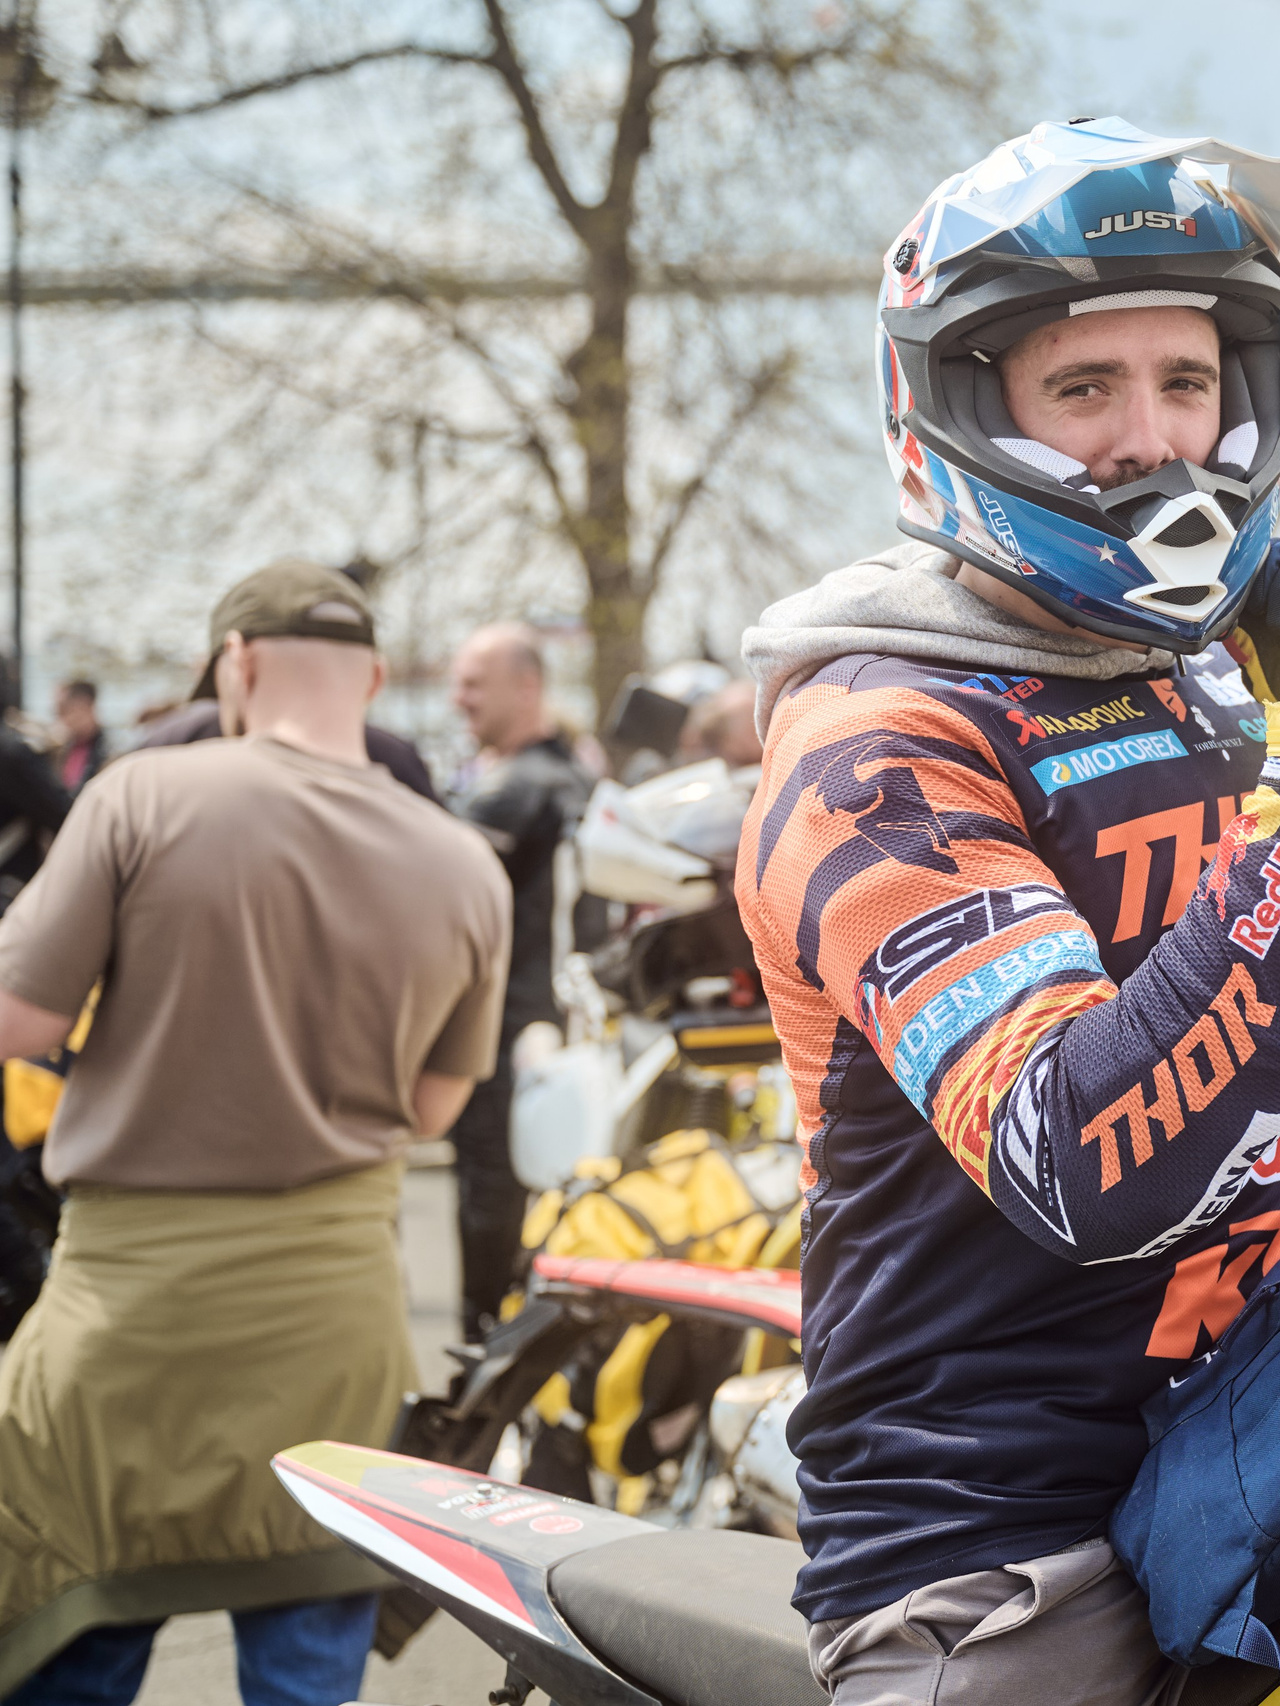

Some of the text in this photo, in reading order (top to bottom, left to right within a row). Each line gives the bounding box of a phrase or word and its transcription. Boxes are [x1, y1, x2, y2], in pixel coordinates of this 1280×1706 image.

[1084, 209, 1197, 240] JUST1
[1070, 734, 1182, 781] MOTOREX
[1095, 790, 1256, 944] TH
[1080, 962, 1277, 1194] THOR
